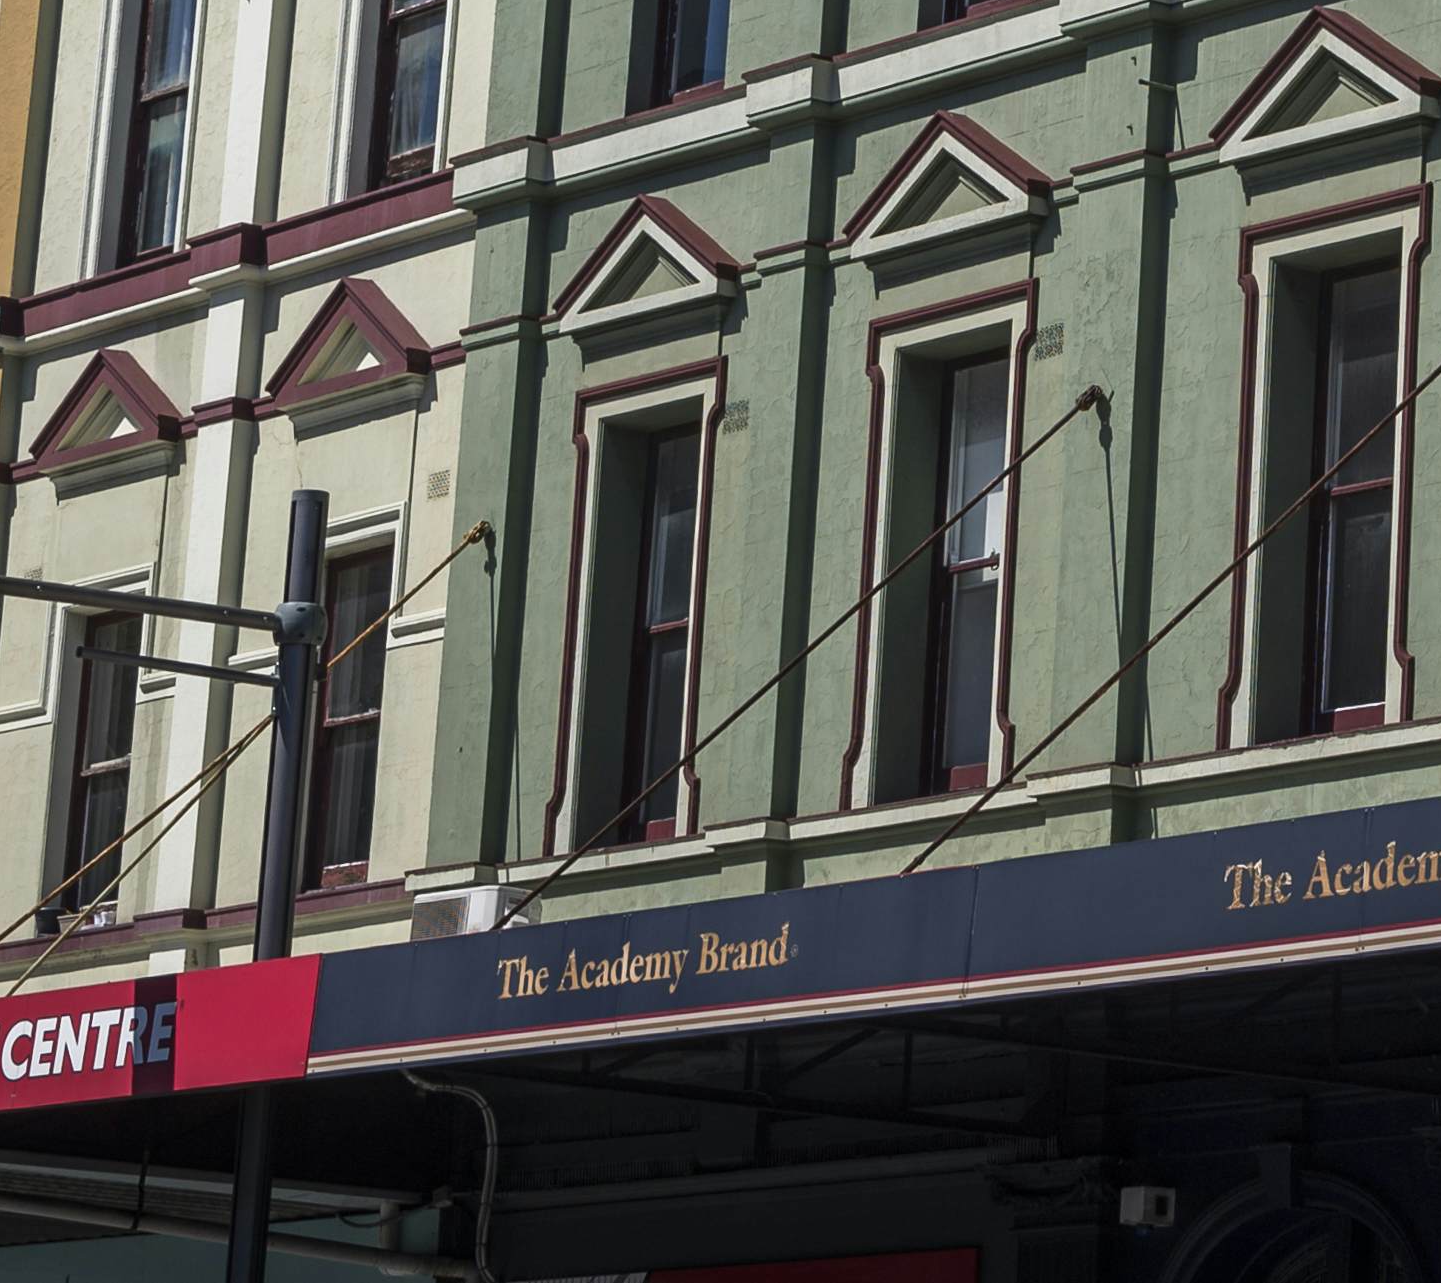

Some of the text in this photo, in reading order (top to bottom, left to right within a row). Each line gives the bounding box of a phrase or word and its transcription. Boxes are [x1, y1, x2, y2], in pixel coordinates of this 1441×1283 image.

[1224, 858, 1292, 910] The
[498, 955, 549, 999] The
[557, 941, 689, 994] Academy
[1, 1002, 177, 1080] CENTRE
